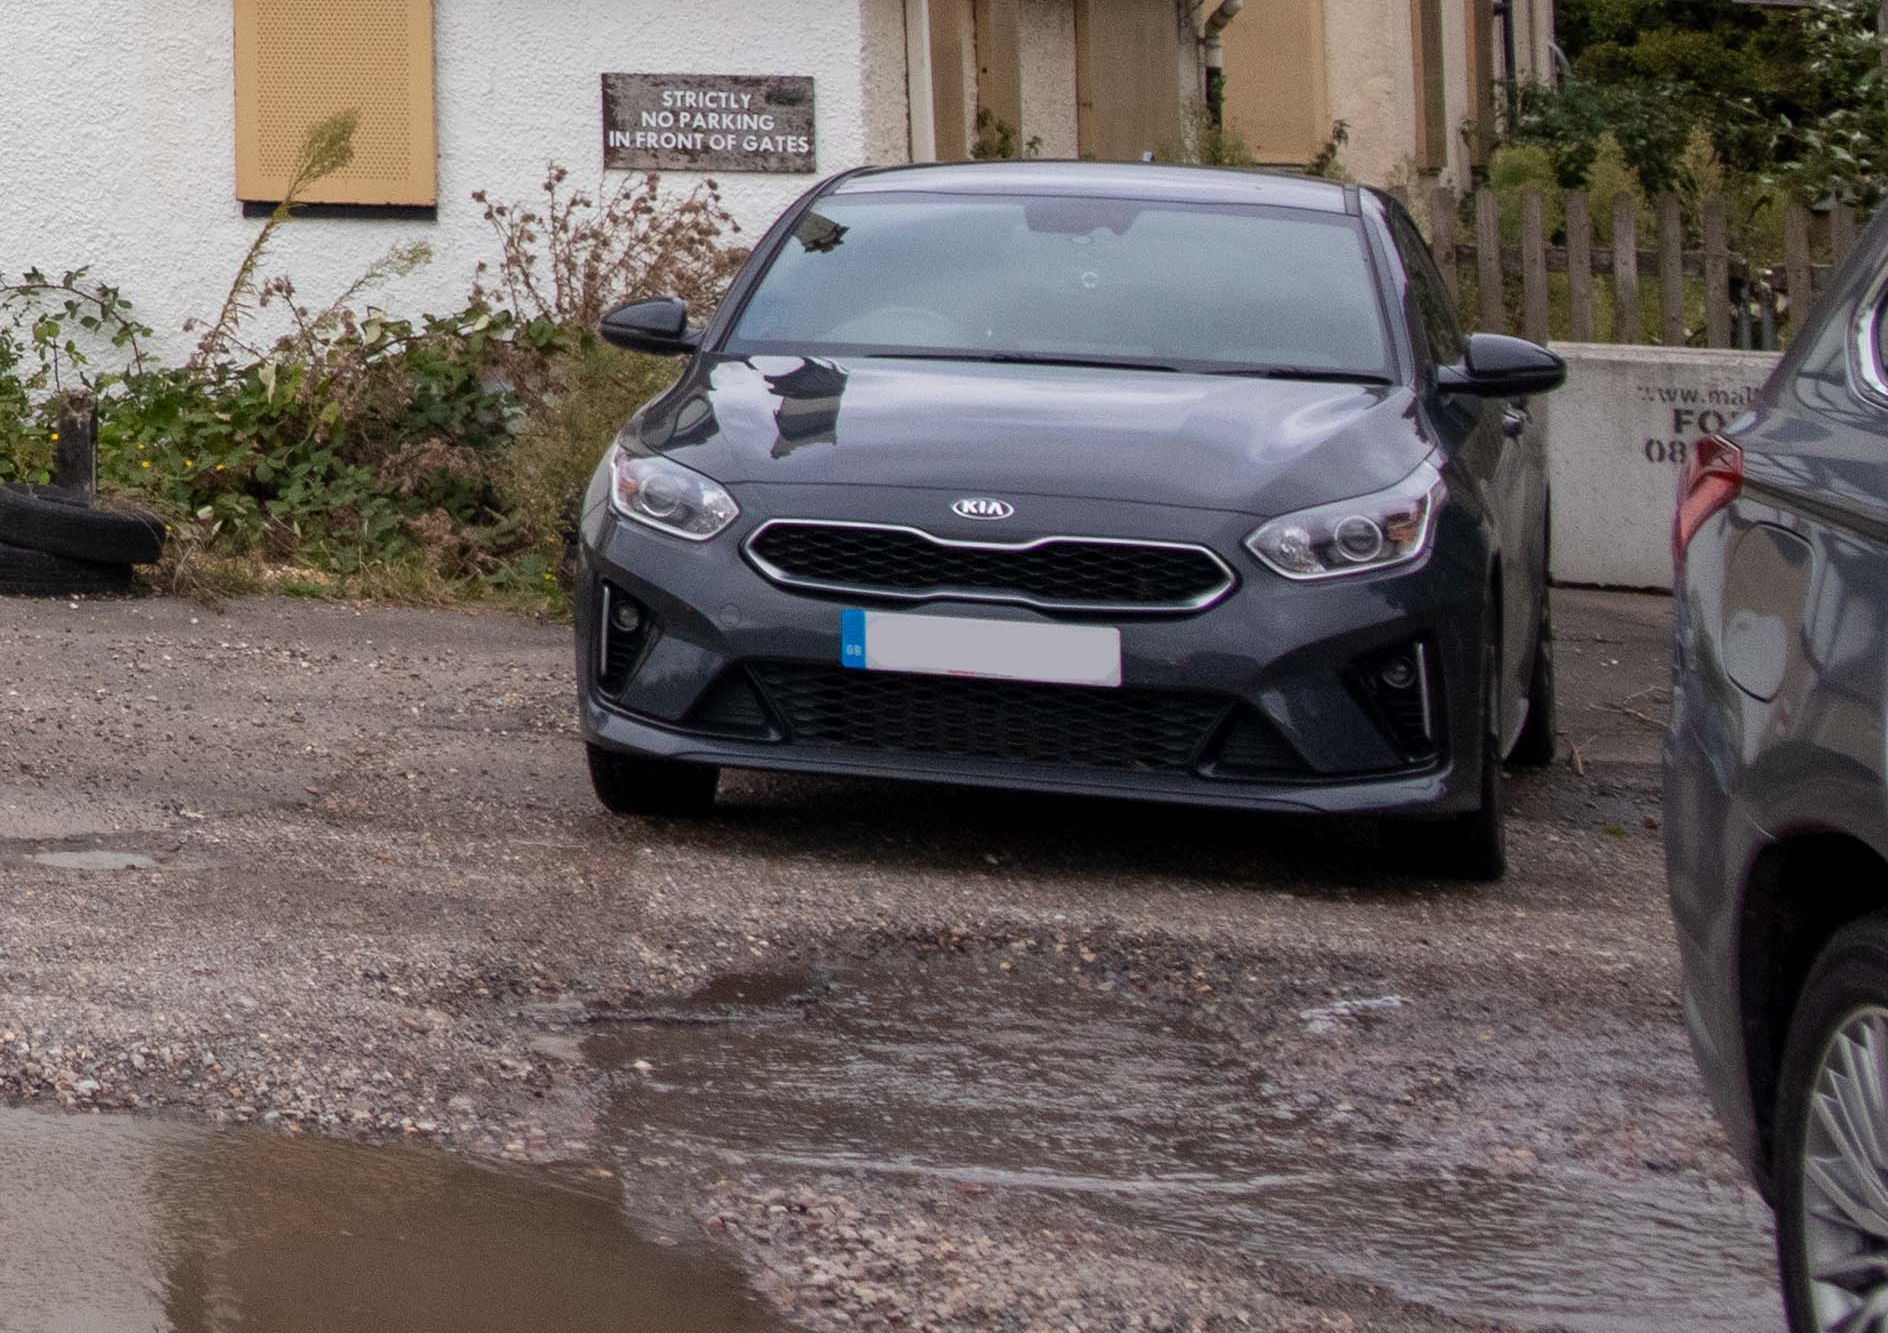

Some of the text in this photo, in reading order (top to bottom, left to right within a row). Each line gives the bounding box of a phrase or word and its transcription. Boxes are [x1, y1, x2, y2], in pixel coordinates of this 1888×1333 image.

[662, 91, 752, 109] STRICTLY
[642, 112, 775, 130] NO PARKING
[609, 131, 810, 153] IN FRONT OF GATES
[1674, 408, 1740, 434] FO
[962, 499, 1004, 516] KIA
